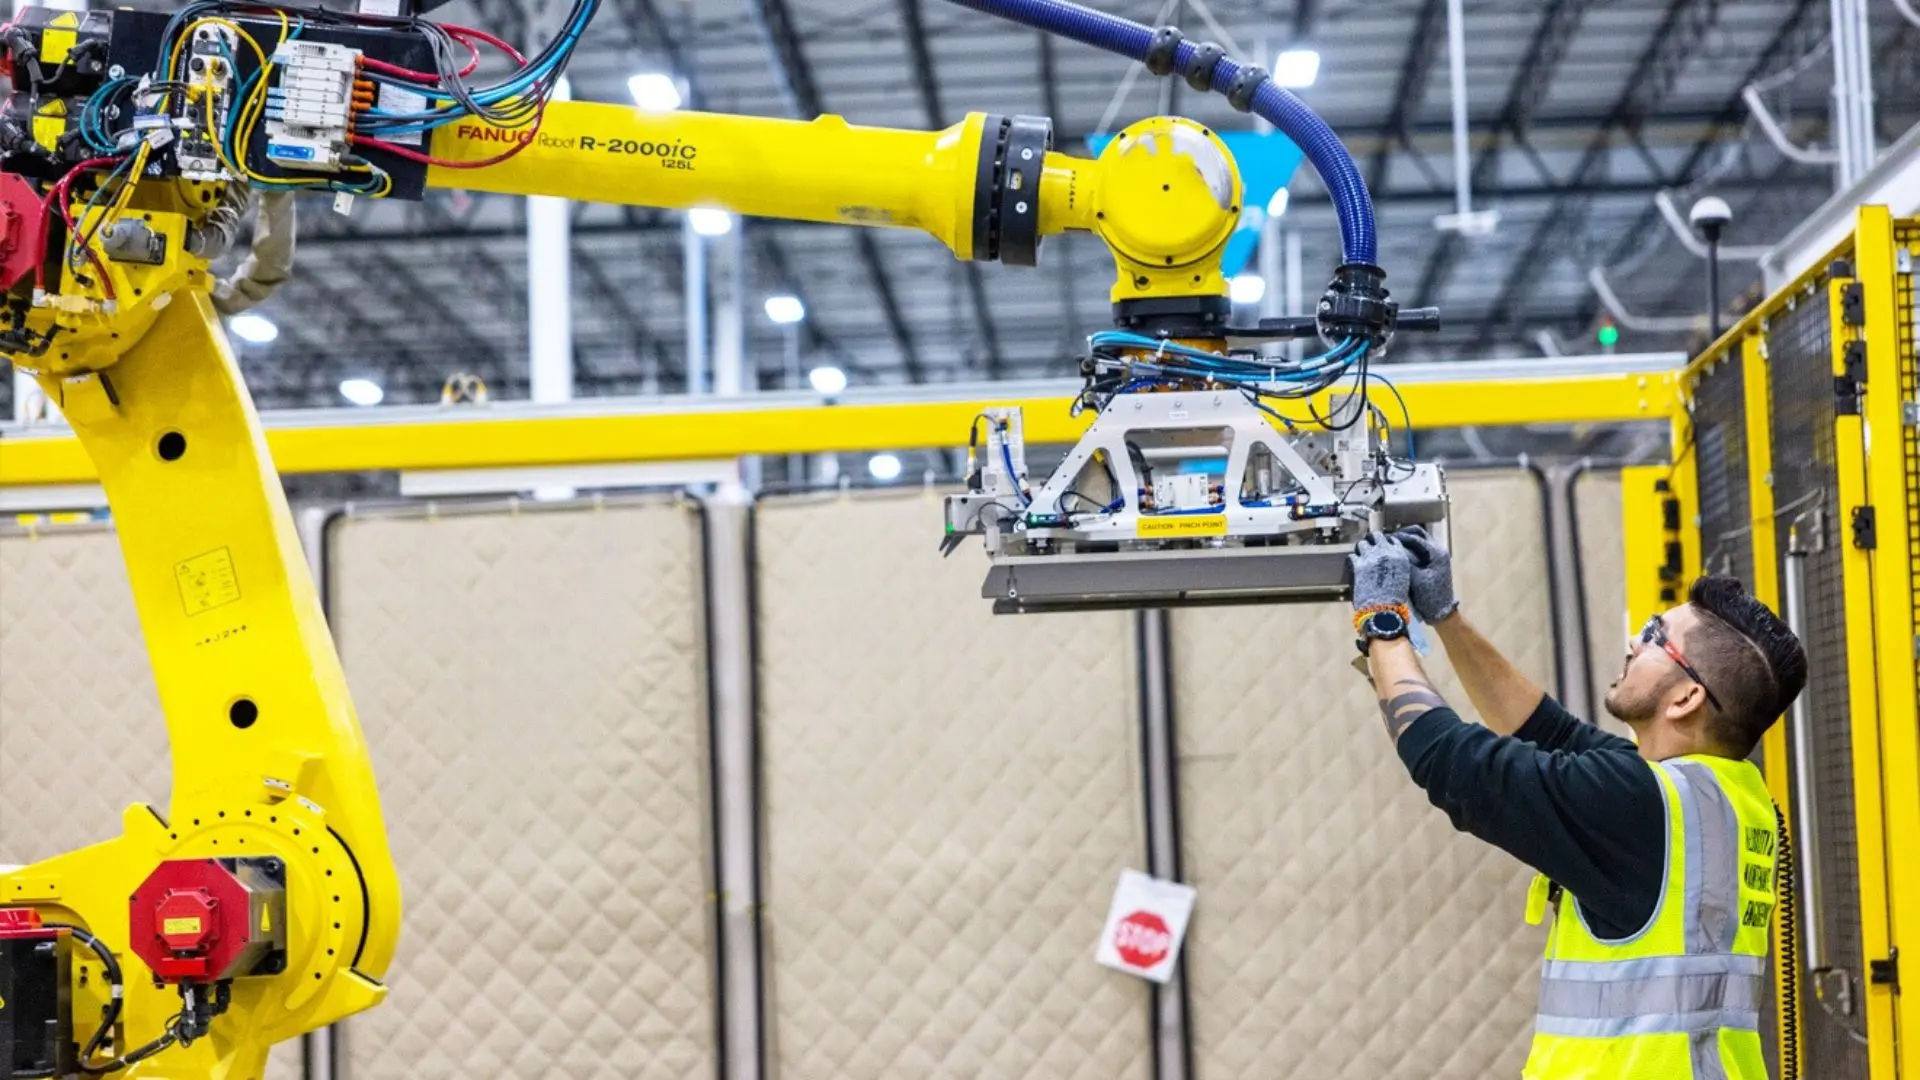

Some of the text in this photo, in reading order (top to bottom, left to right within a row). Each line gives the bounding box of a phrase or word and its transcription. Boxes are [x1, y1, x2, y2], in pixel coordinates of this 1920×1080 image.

[538, 132, 575, 148] Robot
[580, 136, 697, 160] R-2000iC
[661, 159, 696, 171] 125L
[1142, 520, 1224, 530] CAUTION PINCH POINT
[1115, 920, 1170, 955] STOP
